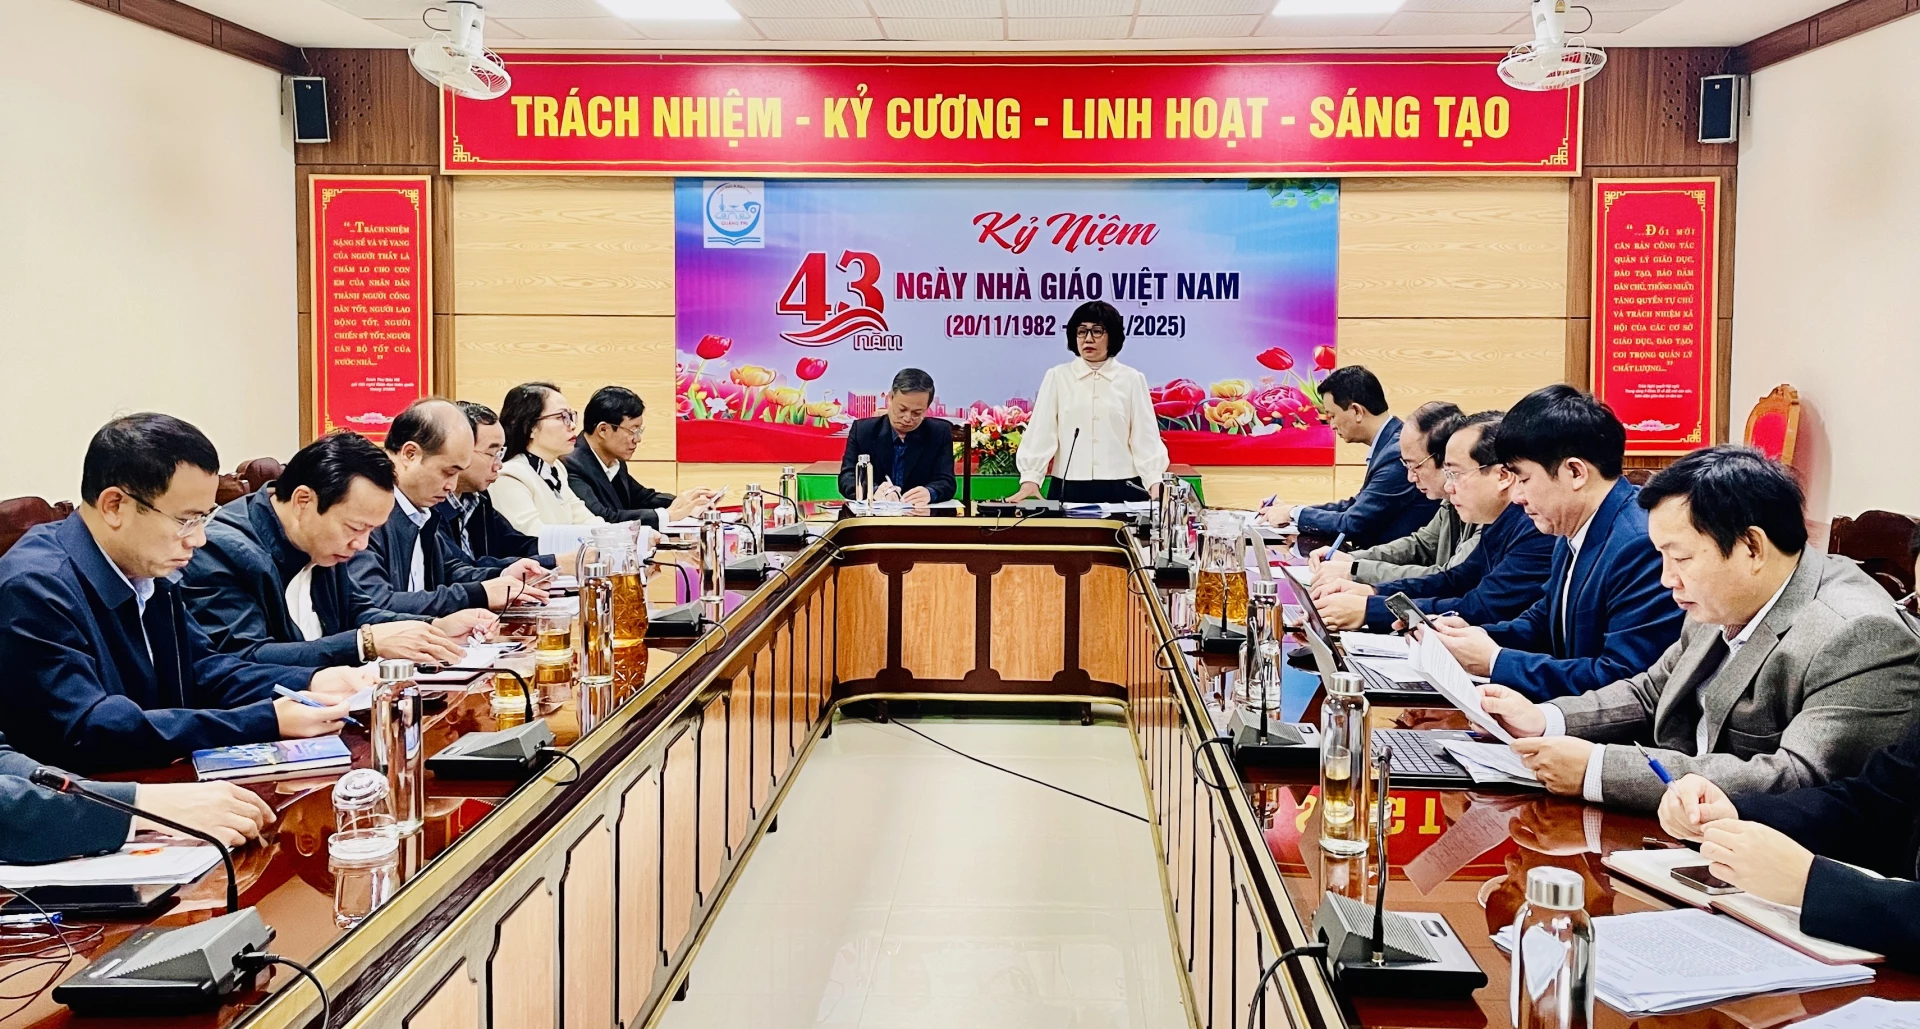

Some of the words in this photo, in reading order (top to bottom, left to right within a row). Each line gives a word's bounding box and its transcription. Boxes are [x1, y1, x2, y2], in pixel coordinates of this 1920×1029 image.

[511, 87, 639, 137] TRÁCH
[653, 89, 782, 147] NHIỆM
[796, 117, 810, 125] -
[824, 83, 874, 139] KỶ
[887, 94, 1020, 139] CƯƠNG
[1034, 118, 1048, 126] -
[1062, 97, 1145, 139] LINH
[1166, 96, 1269, 148] HOẠT
[1281, 117, 1295, 125] -
[1309, 87, 1420, 139] SÁNG
[1434, 96, 1510, 147] TẠO
[973, 211, 1039, 254] Kỷ
[1046, 212, 1160, 253] Niệm
[777, 249, 885, 324] 43
[896, 266, 968, 300] NGÀY
[976, 266, 1032, 300] NHÀ
[1041, 266, 1103, 300] GIÁO
[1112, 266, 1168, 306] VIỆT
[1177, 272, 1240, 300] NAM
[946, 314, 1056, 338] (20/11/1982
